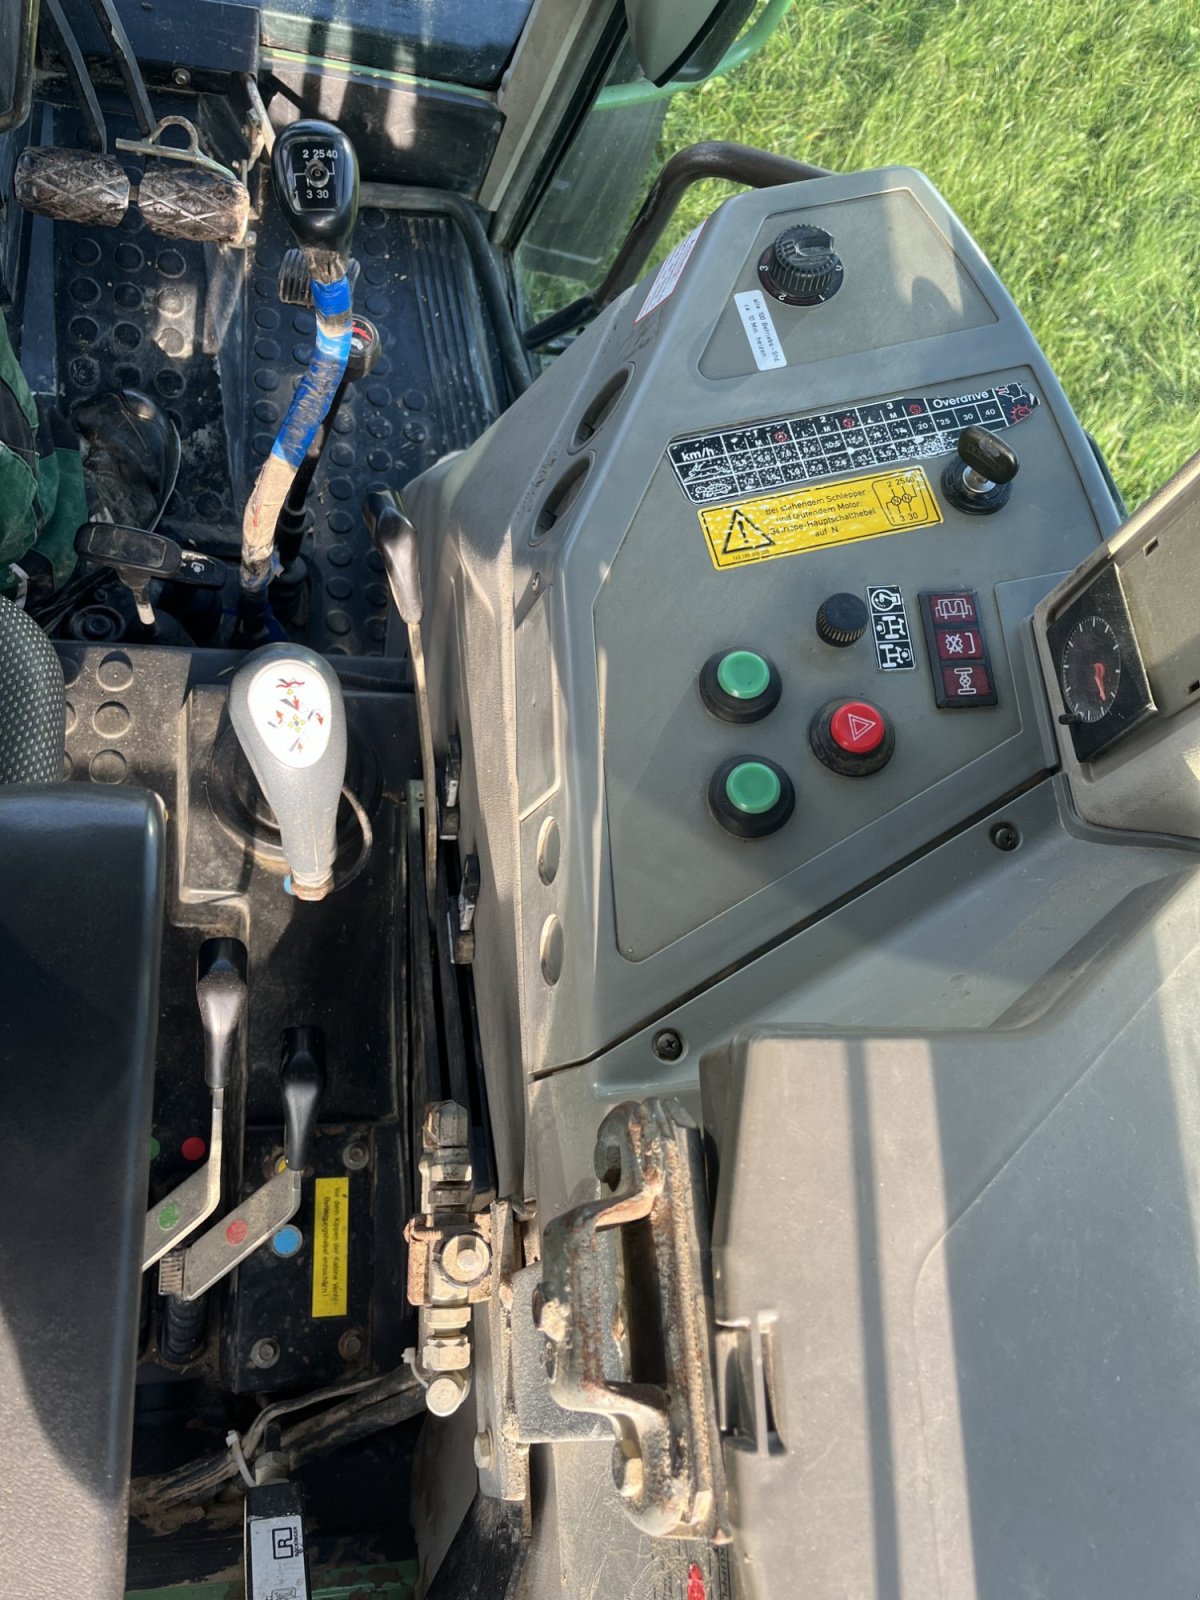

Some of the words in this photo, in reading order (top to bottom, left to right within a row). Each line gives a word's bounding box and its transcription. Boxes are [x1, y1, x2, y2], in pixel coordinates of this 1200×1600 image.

[302, 149, 309, 158] 2
[313, 149, 325, 158] 25
[326, 149, 338, 159] 40
[306, 190, 313, 199] 3
[317, 190, 329, 199] 30
[932, 390, 989, 409] Overdrive
[918, 422, 929, 431] 20
[940, 418, 951, 426] 25
[962, 412, 974, 421] 30
[984, 408, 996, 417] 40
[681, 446, 715, 462] km/h
[895, 477, 906, 486] 25
[765, 507, 779, 515] Bei
[826, 489, 866, 503] Schlepper
[907, 512, 919, 521] 30
[815, 529, 828, 537] auf
[831, 526, 839, 534] N
